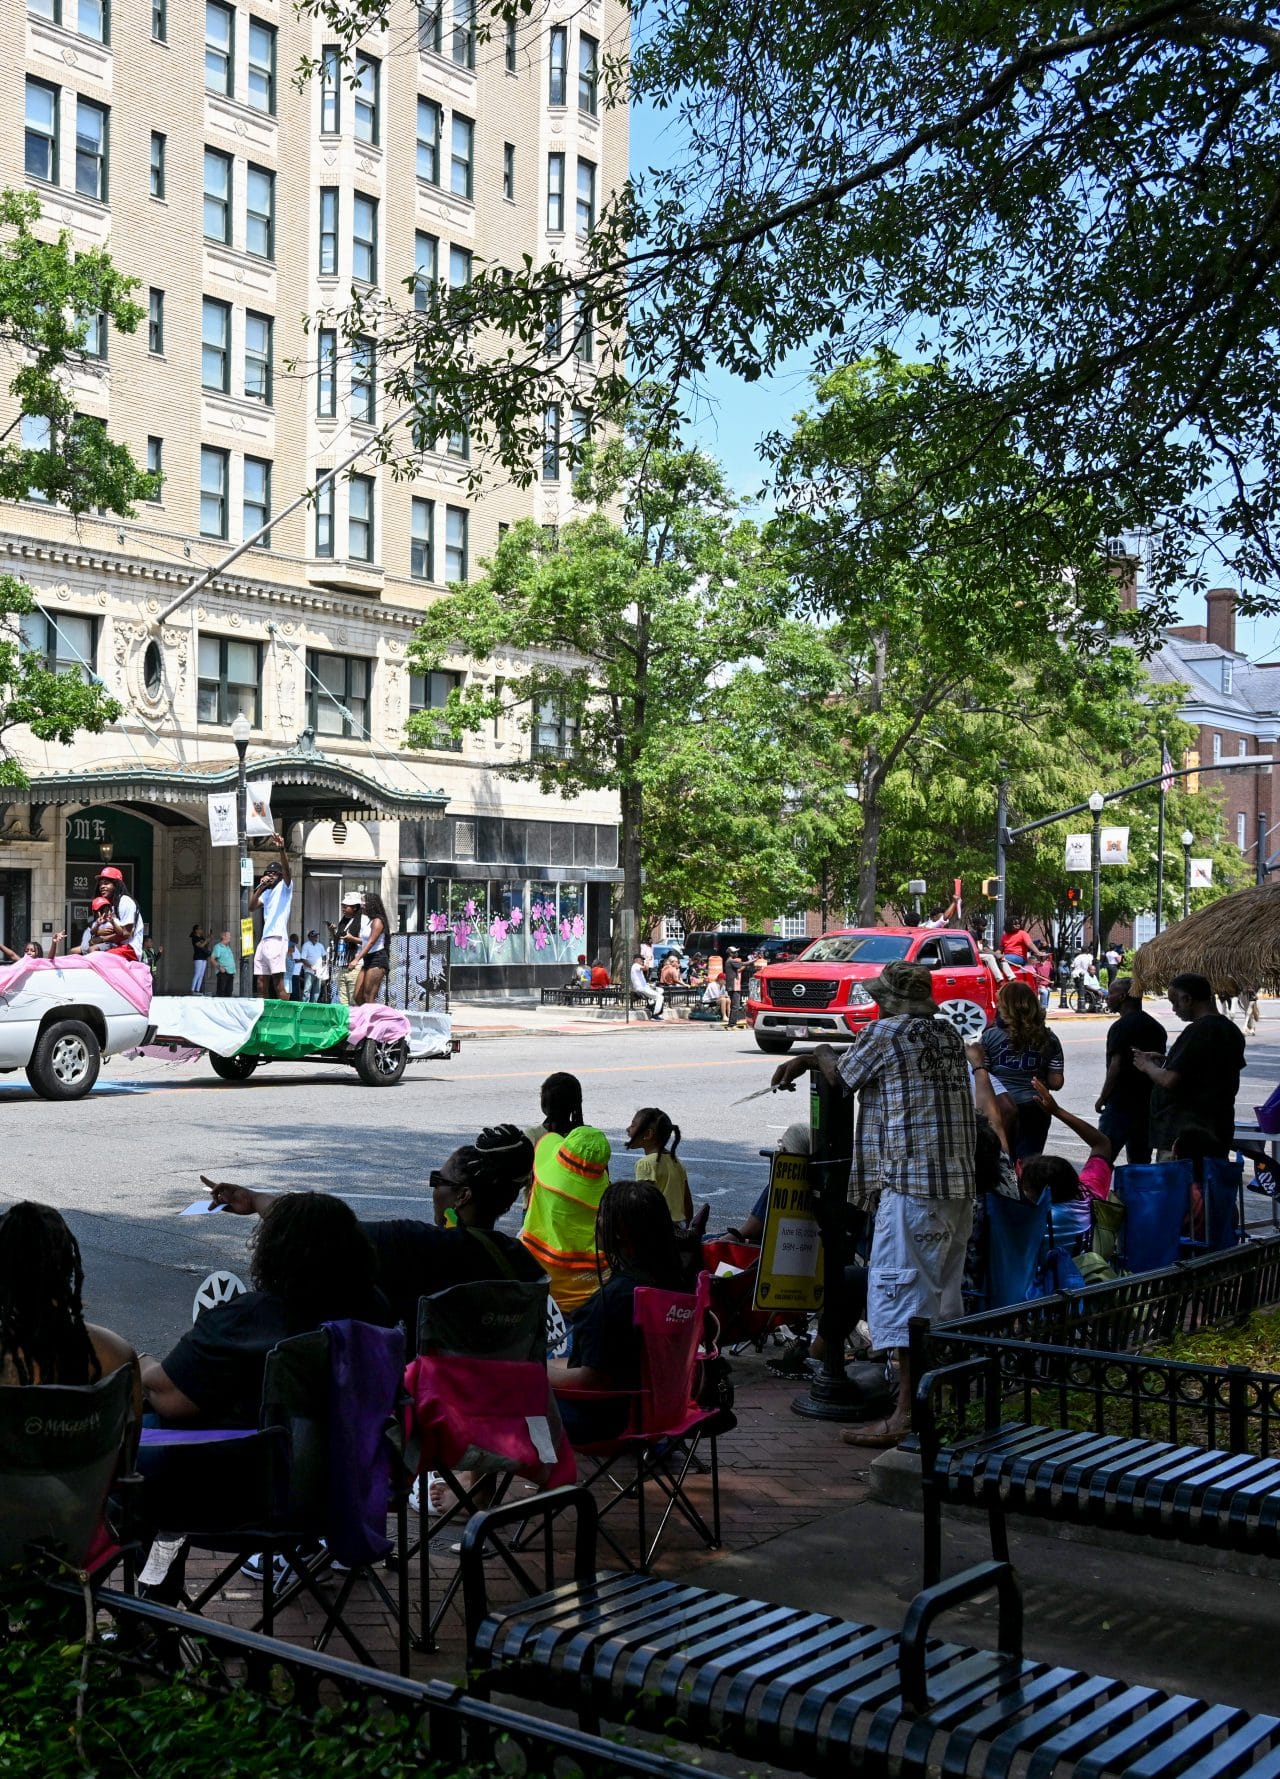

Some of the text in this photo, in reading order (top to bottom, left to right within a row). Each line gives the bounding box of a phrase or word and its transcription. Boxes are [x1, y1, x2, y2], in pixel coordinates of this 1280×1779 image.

[74, 877, 88, 886] 523
[776, 1161, 809, 1180] SPECIA
[773, 1188, 788, 1210] NO
